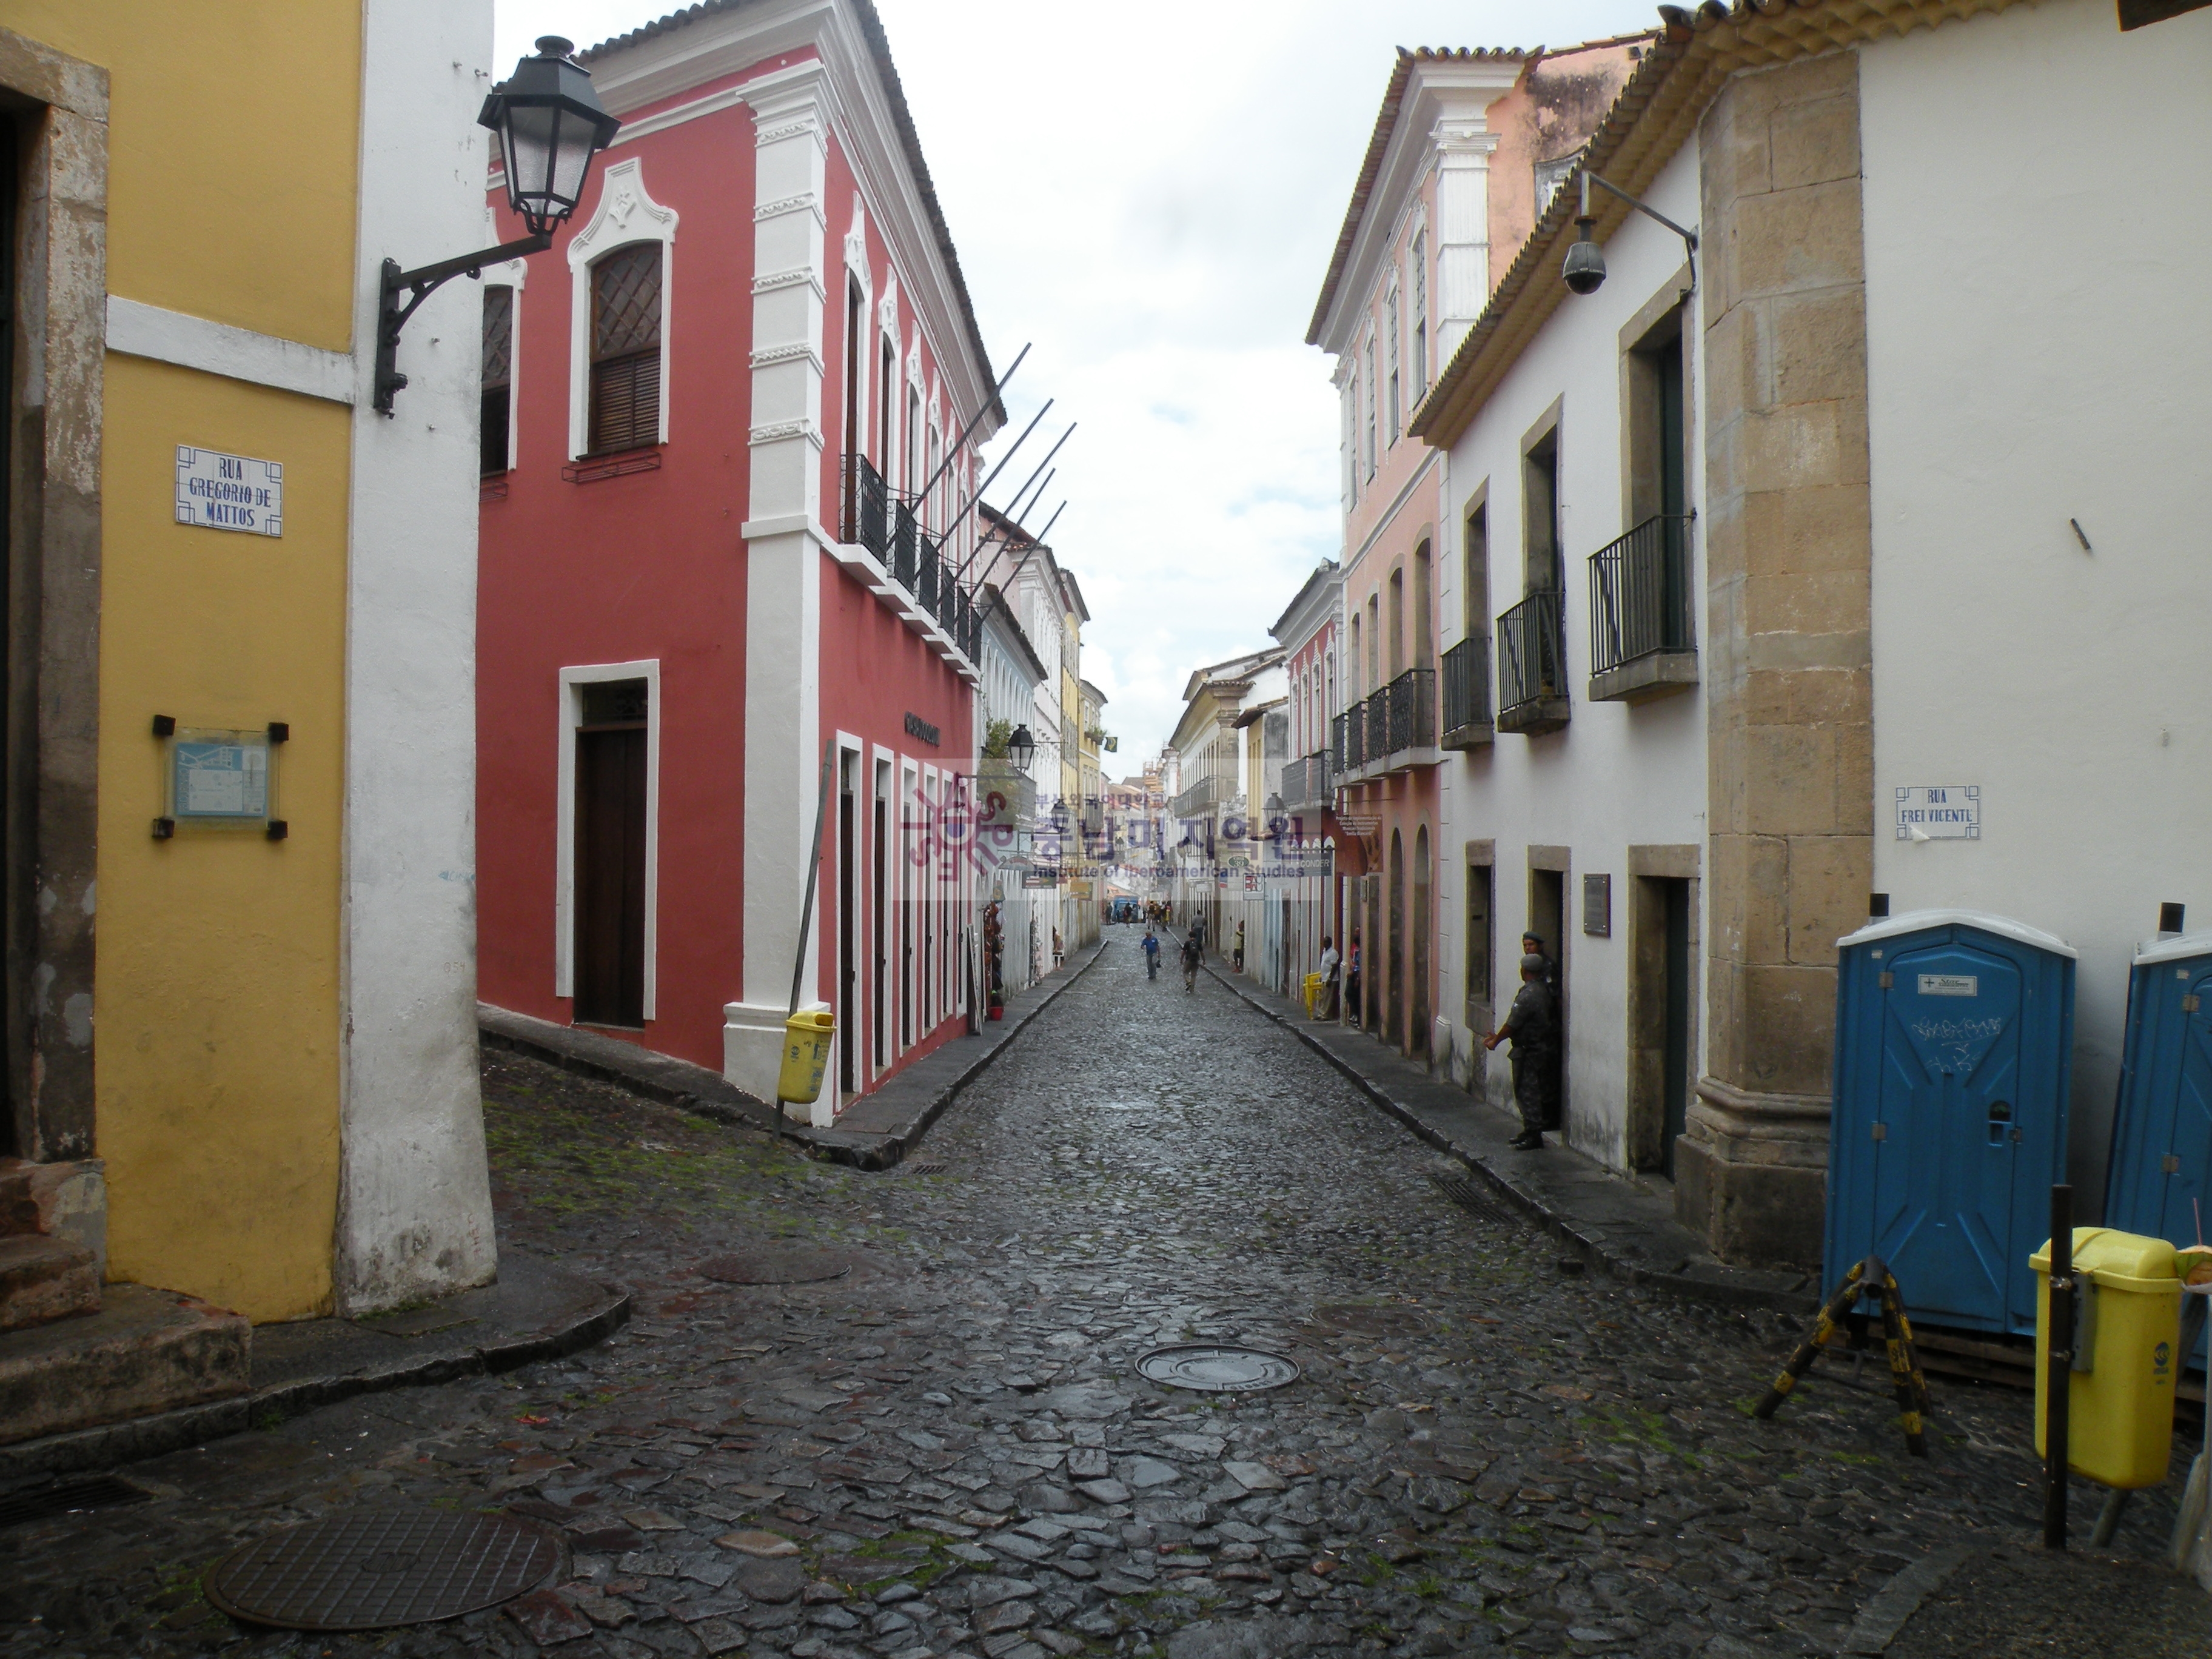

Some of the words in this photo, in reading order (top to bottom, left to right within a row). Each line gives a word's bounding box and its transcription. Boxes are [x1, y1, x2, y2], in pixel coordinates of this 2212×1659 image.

[219, 457, 243, 481] RUA
[189, 477, 252, 504] GREGORIO
[255, 488, 272, 508] DE
[206, 501, 255, 527] MATTOS
[1927, 788, 1947, 804] RUA
[1902, 809, 1926, 823] FREI
[1300, 859, 1330, 868] CONDER
